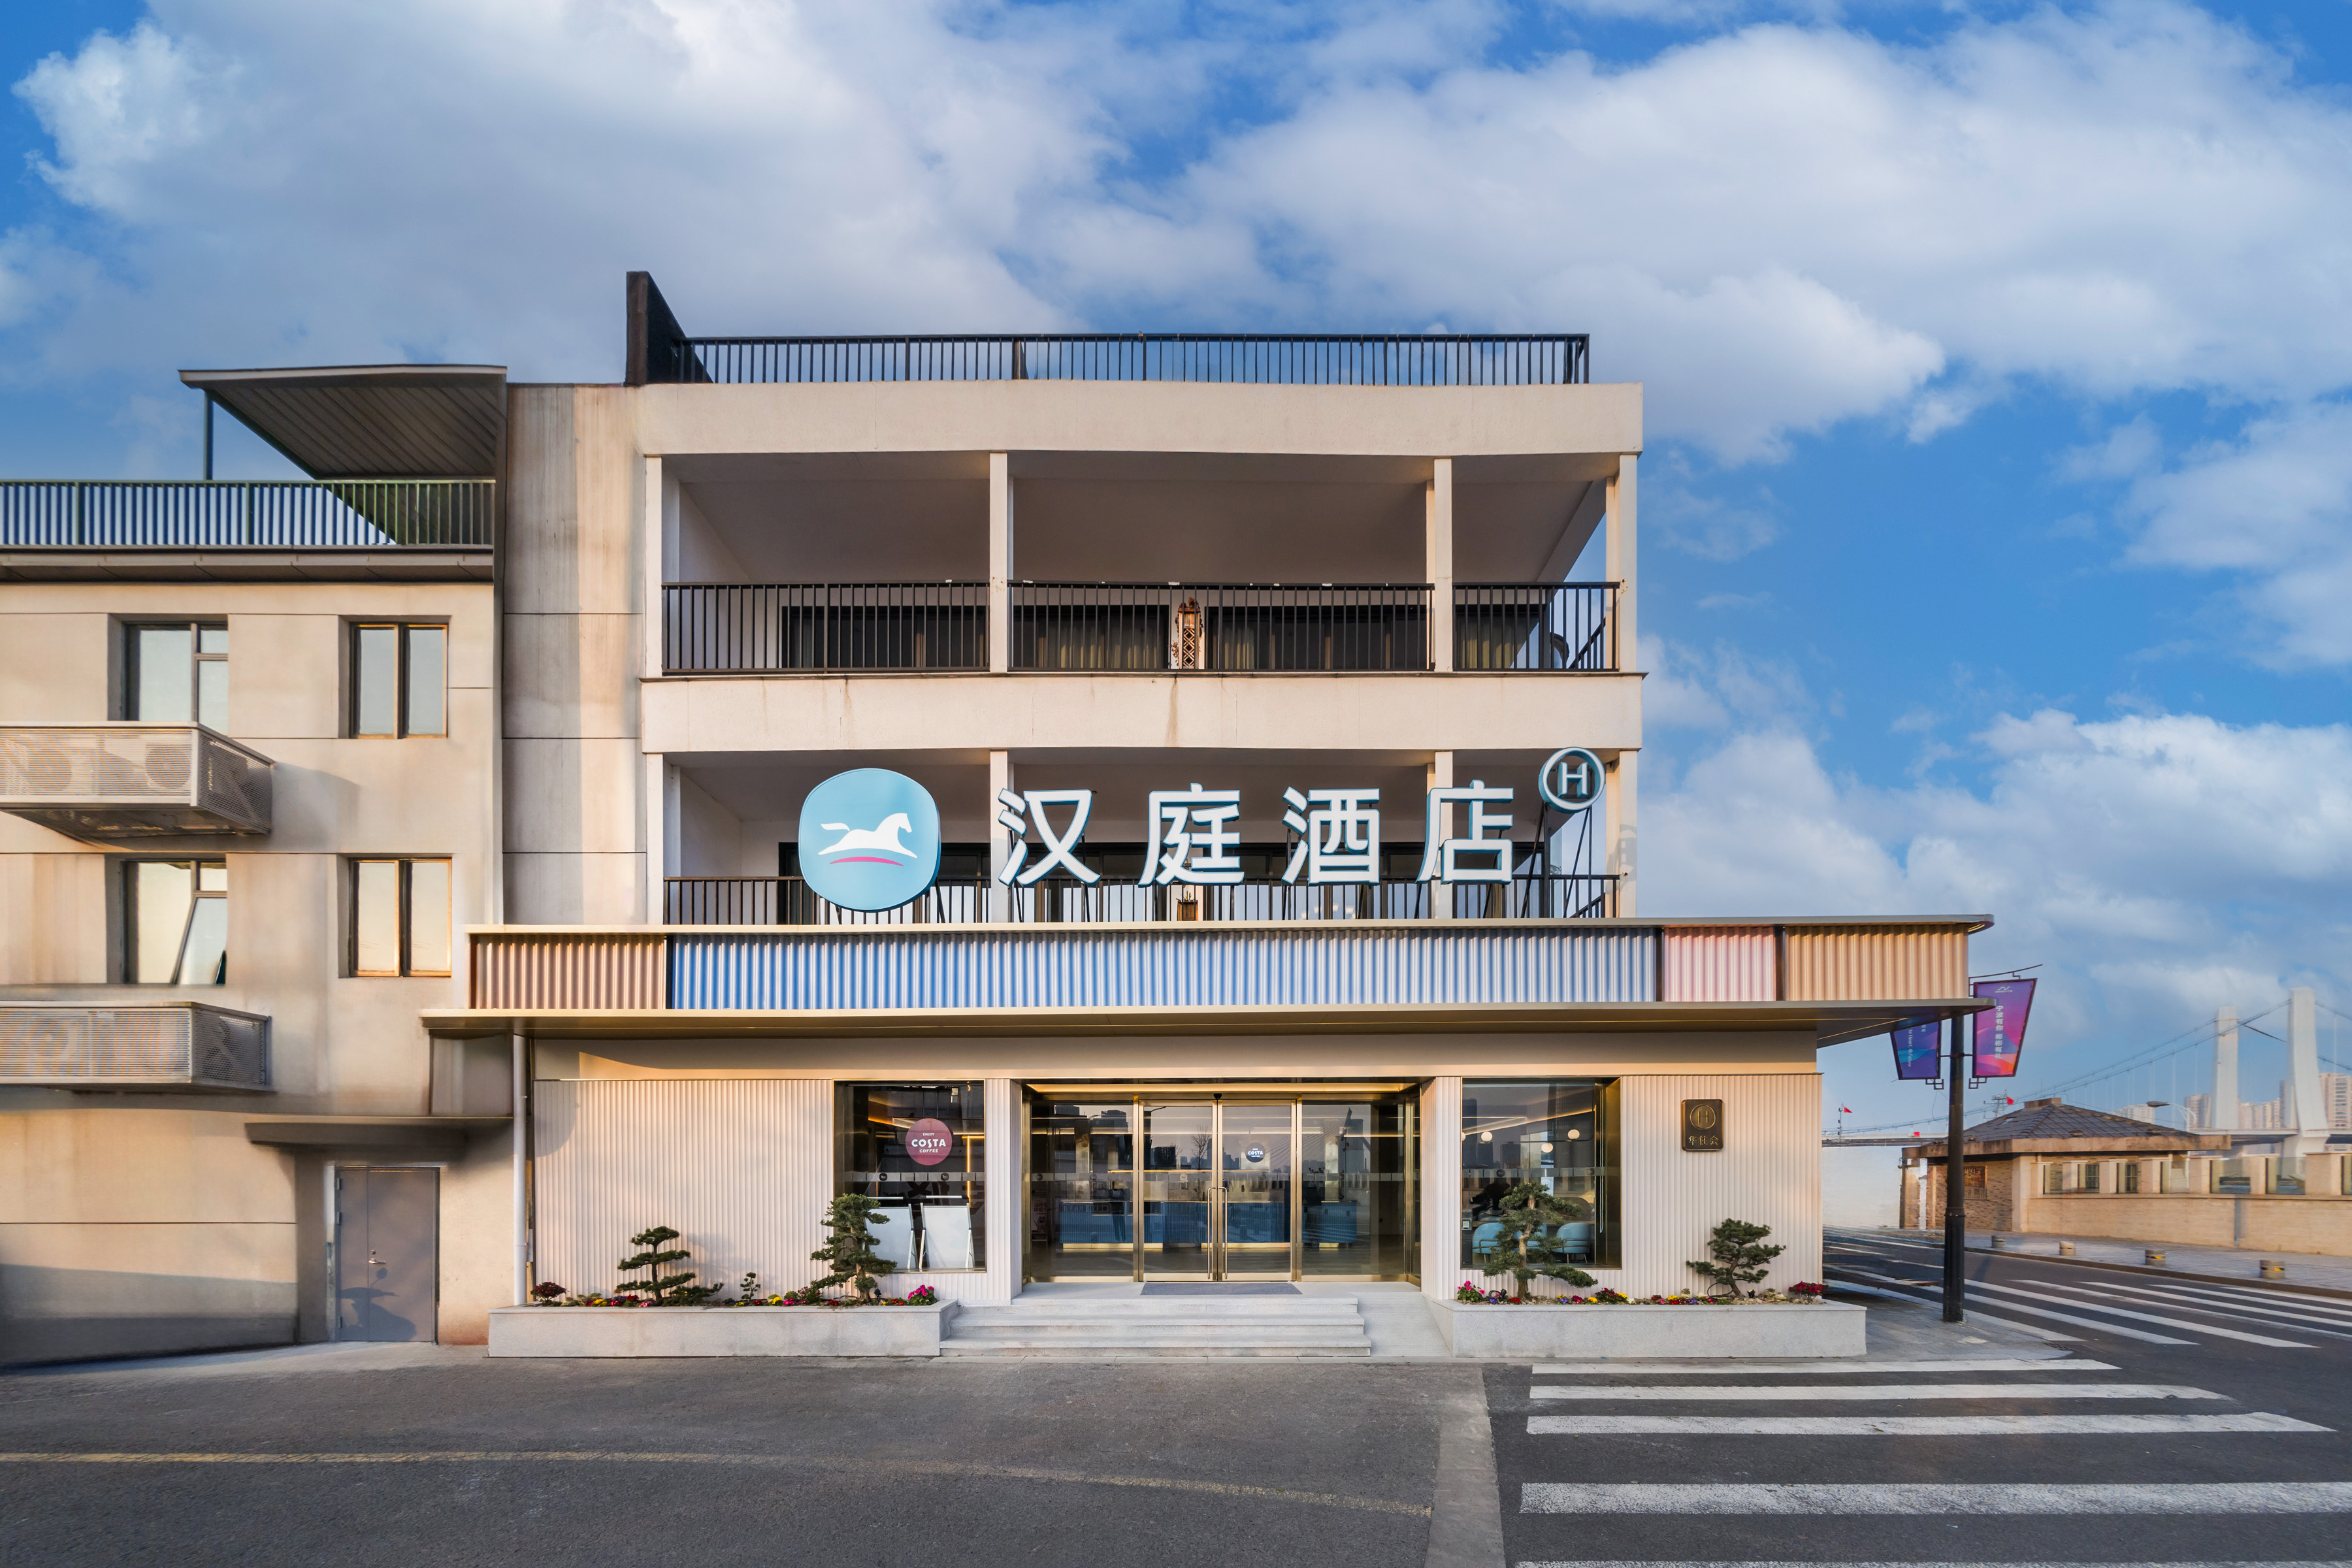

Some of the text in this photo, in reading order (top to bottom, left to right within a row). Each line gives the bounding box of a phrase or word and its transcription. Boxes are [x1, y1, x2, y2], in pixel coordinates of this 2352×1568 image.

[998, 779, 1514, 888] 汉庭酒店
[1994, 1005, 2004, 1059] 宁波有你 彬彬有礼
[911, 1138, 946, 1148] COSTA
